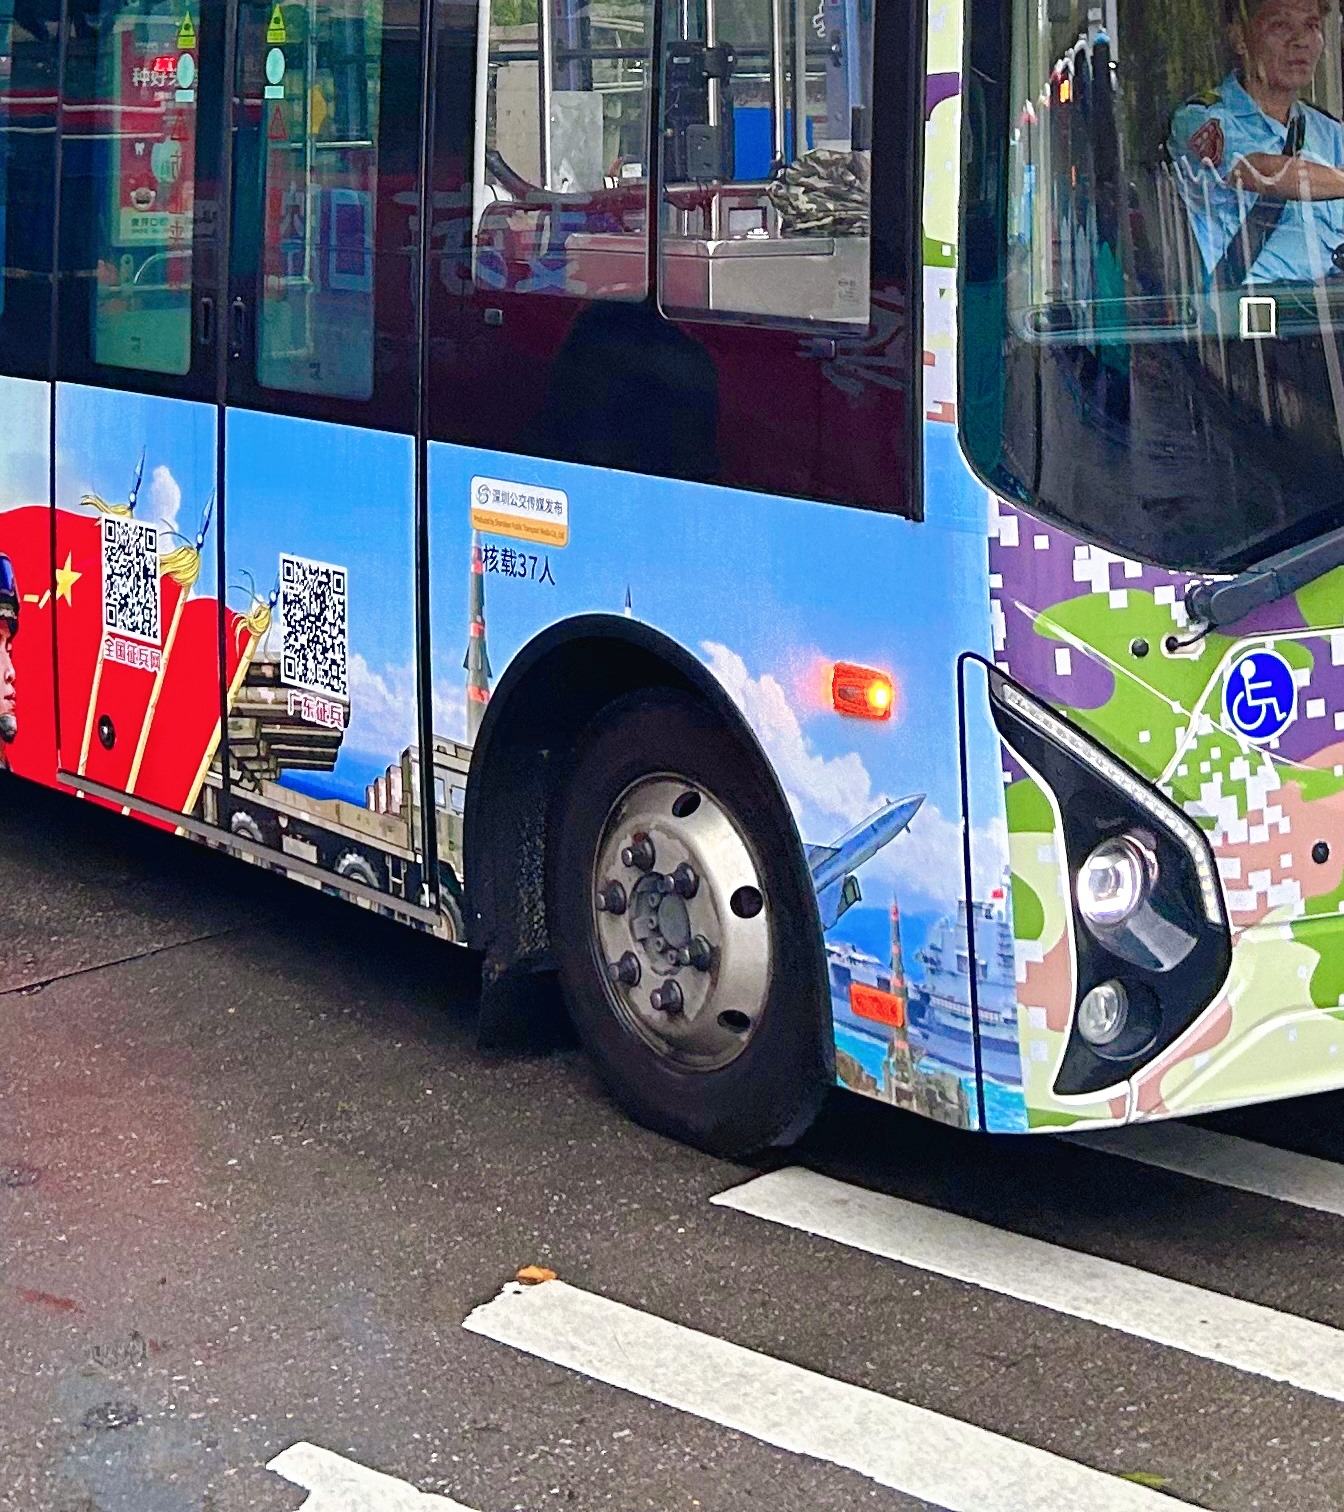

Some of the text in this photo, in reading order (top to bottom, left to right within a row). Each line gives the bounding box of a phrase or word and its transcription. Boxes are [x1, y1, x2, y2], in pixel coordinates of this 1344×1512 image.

[491, 488, 564, 516] 深圳公交传媒发布
[482, 543, 556, 586] 核载37人
[103, 637, 162, 672] 全国征兵网
[288, 690, 343, 730] 广东征兵
